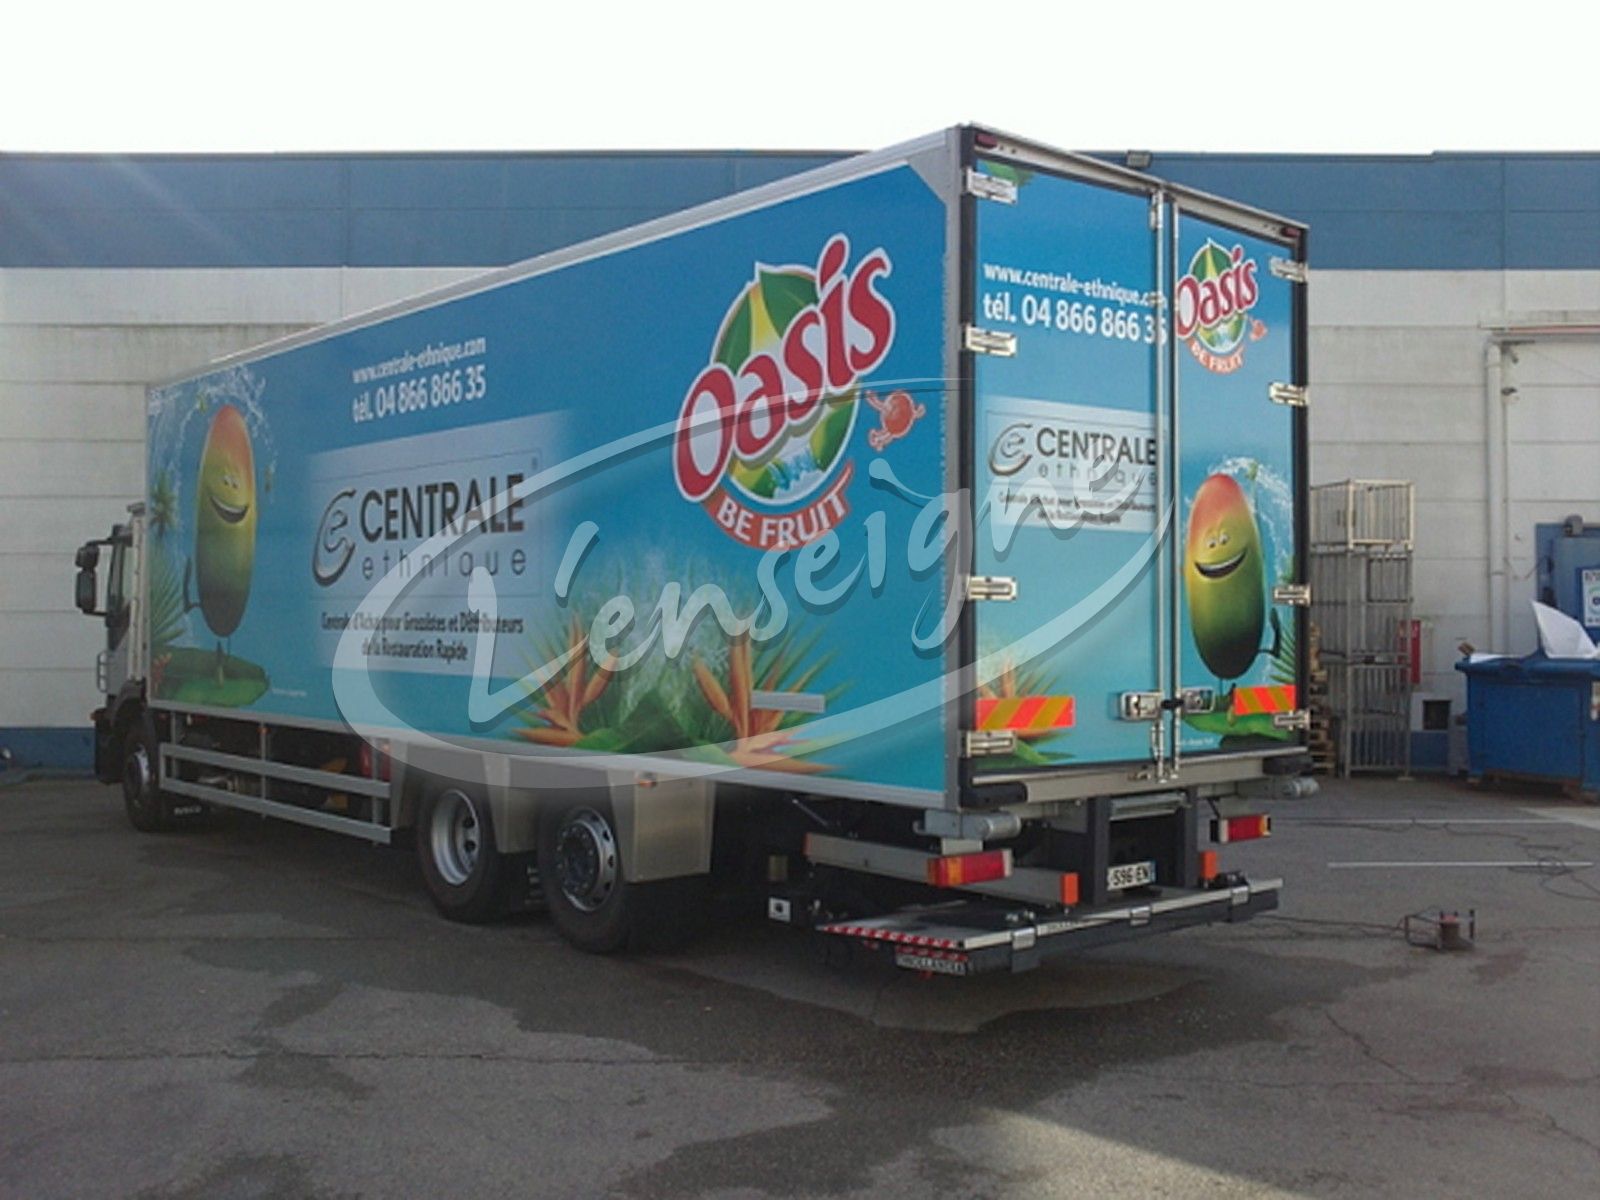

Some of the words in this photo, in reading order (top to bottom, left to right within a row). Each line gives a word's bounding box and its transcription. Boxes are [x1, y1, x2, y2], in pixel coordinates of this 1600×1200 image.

[983, 263, 1168, 309] www.centrale-ethnique.c
[1175, 244, 1258, 339] Oasis
[983, 291, 1016, 323] tél.
[1022, 294, 1051, 327] 04
[1056, 299, 1097, 334] 866
[1101, 307, 1140, 341] 866
[376, 385, 395, 418] 04
[398, 377, 427, 414] 866
[431, 369, 462, 407] 866
[465, 364, 486, 400] 35
[673, 233, 896, 501] Oasis
[1036, 427, 1157, 465] CENTRALE
[360, 473, 524, 542] CENTRALE
[716, 495, 752, 541] BE
[760, 491, 847, 549] FRUIT
[362, 548, 527, 582] ethnique
